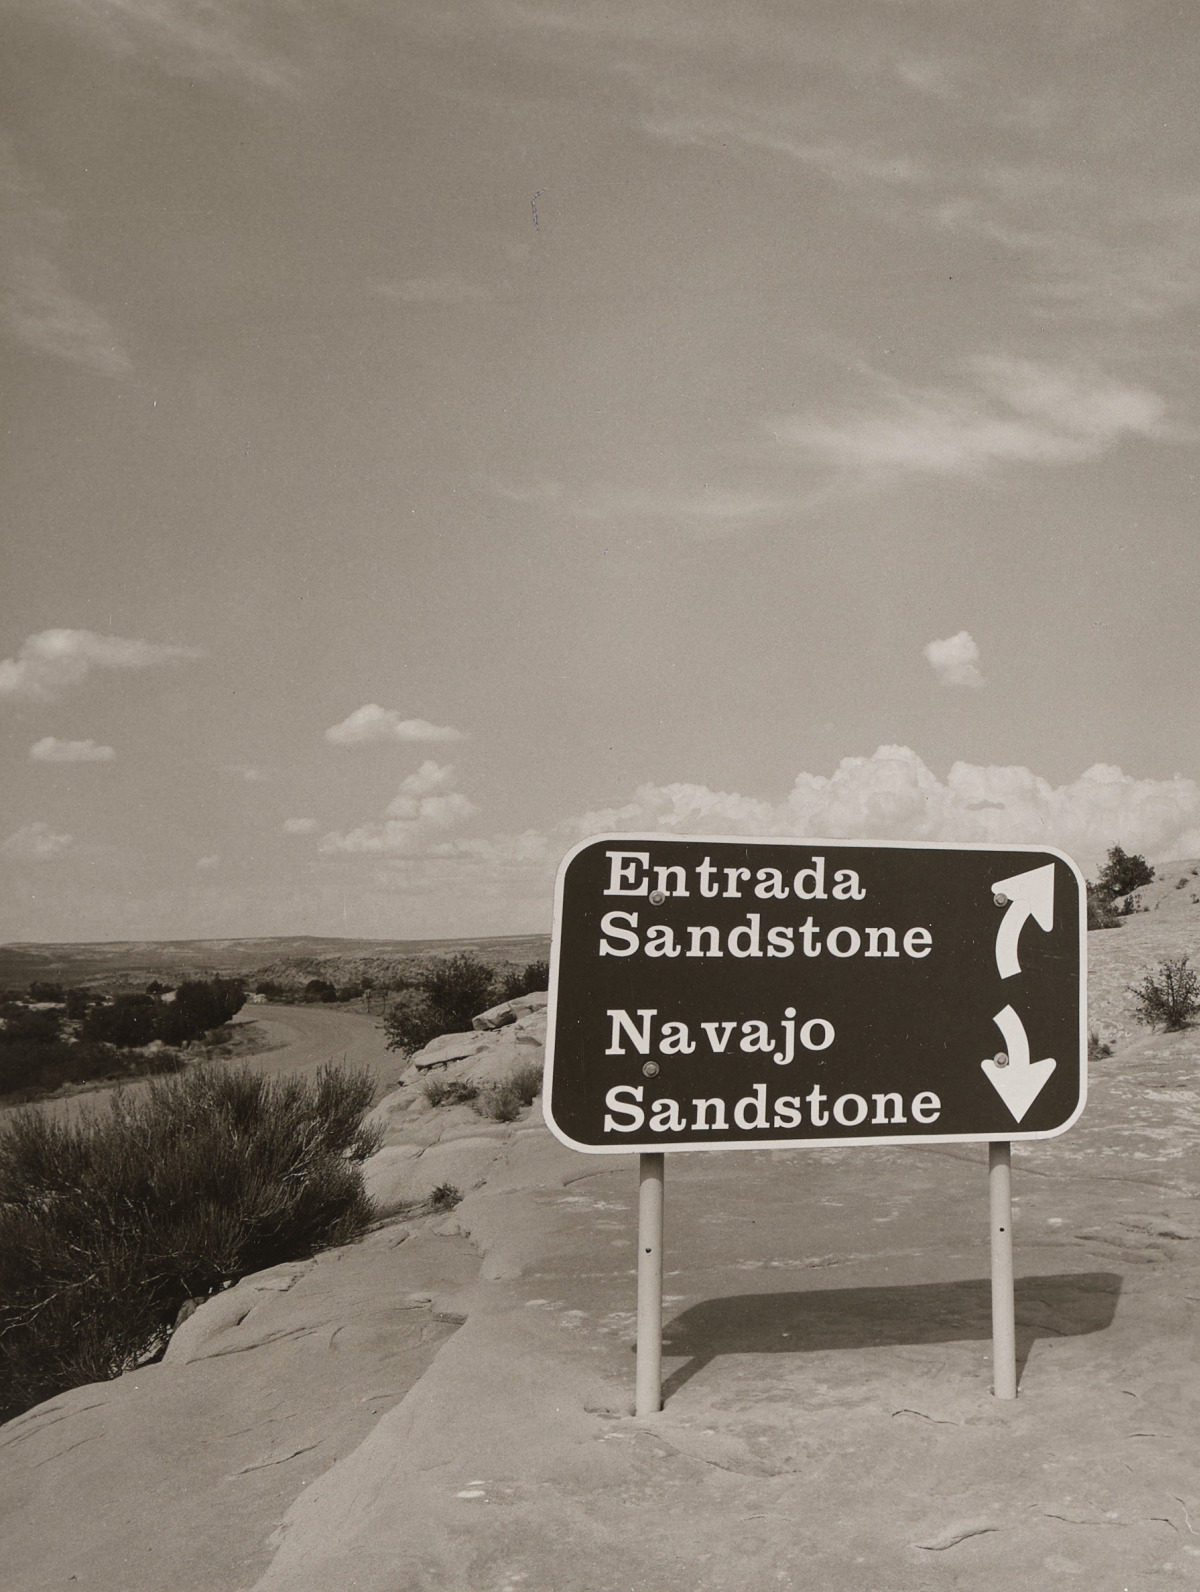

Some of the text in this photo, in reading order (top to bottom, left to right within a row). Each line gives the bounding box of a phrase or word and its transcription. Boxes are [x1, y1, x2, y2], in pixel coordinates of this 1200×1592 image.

[603, 850, 867, 901] Entrada
[599, 910, 933, 959] Sandstone
[605, 1006, 836, 1066] Navajo
[603, 1083, 942, 1133] Sandstone
